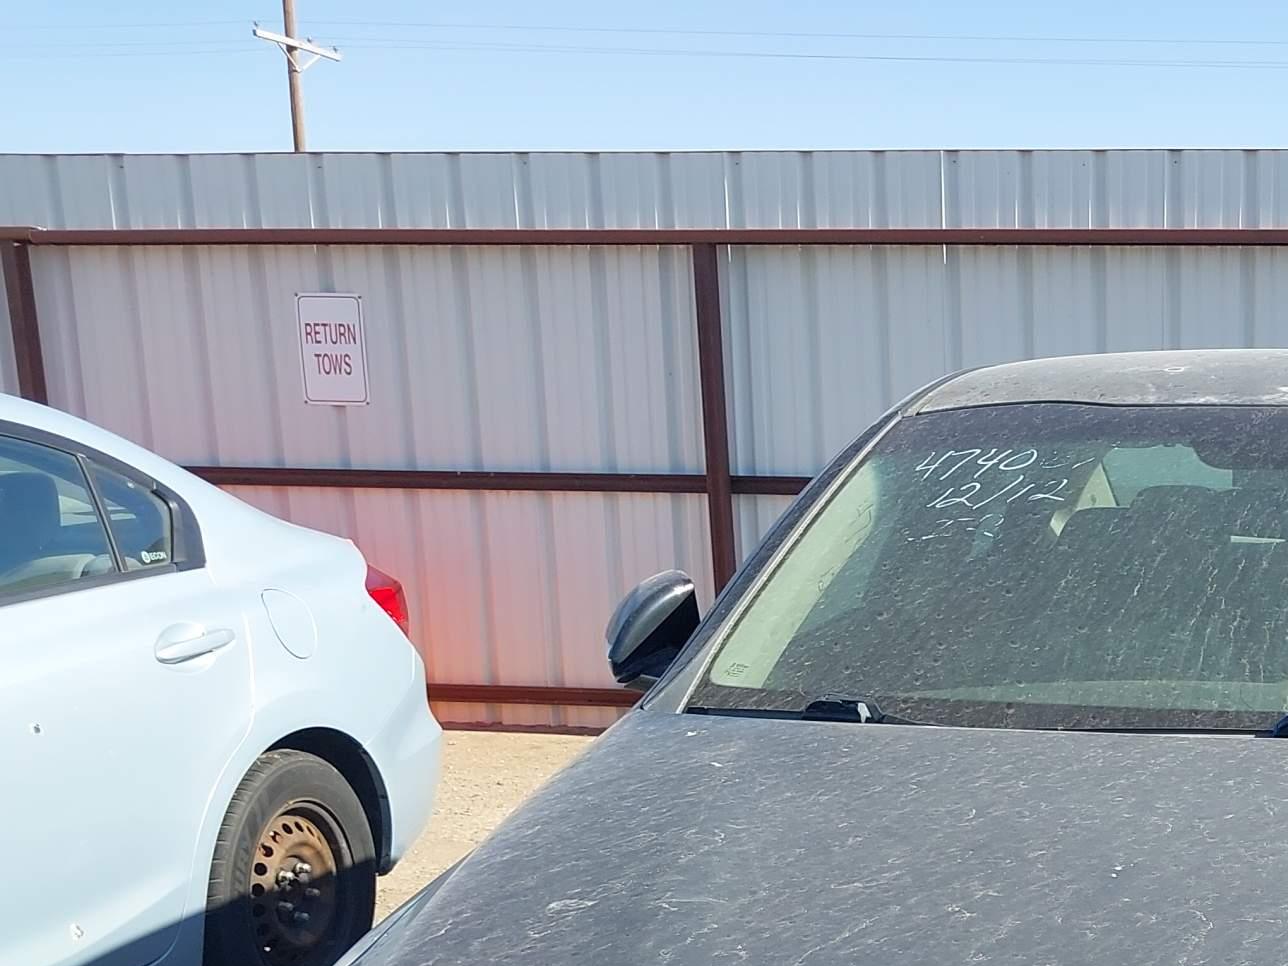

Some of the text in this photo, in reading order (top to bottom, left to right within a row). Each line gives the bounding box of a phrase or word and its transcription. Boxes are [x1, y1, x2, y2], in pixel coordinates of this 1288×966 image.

[304, 322, 357, 345] RETURN
[314, 353, 353, 376] TOWS
[926, 474, 1069, 510] 12/12
